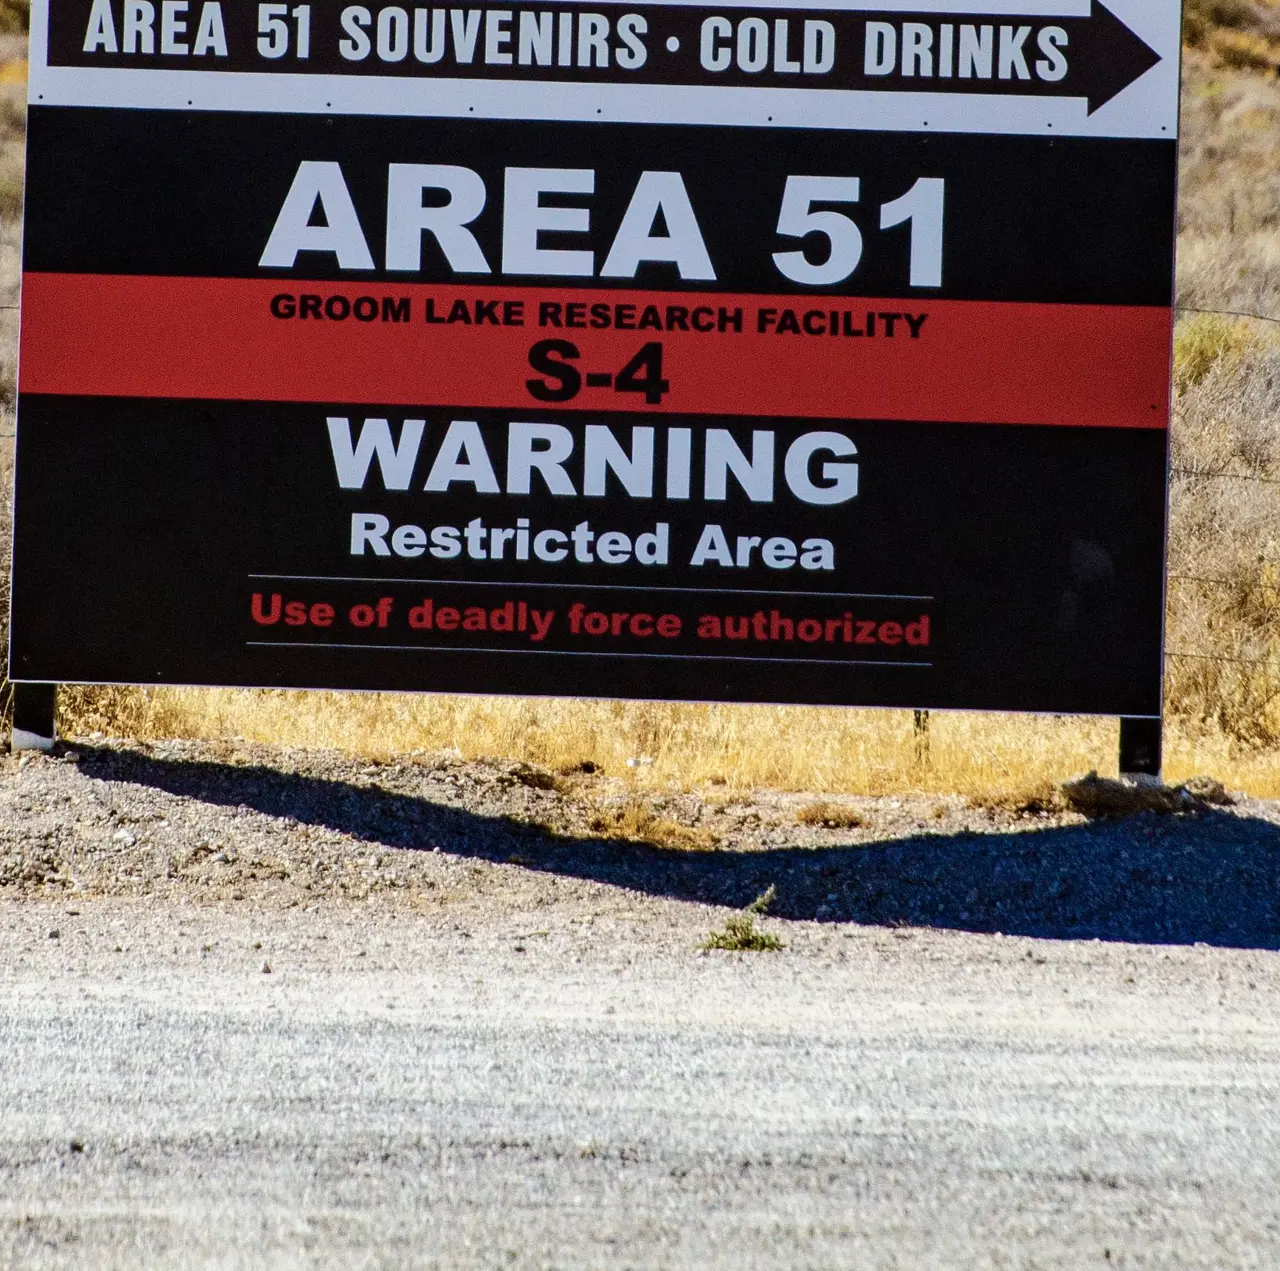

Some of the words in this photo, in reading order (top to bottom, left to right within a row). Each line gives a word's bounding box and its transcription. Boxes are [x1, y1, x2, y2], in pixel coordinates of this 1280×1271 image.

[83, 0, 228, 56] AREA
[257, 4, 310, 58] 51
[339, 6, 647, 69] SOUVENIRS
[700, 16, 835, 73] COLD
[864, 21, 1068, 81] DRINKS
[258, 161, 716, 280] AREA
[772, 175, 944, 287] 51
[270, 294, 410, 322] GROOM
[426, 299, 524, 326] LAKE
[539, 302, 742, 333] RESEARCH
[757, 309, 928, 338] FACILITY
[526, 339, 669, 404] S-4
[327, 417, 858, 505] WARNING
[351, 513, 669, 564] Restricted
[690, 525, 834, 570] Area
[251, 592, 335, 626] Use
[349, 597, 393, 627] of
[409, 599, 554, 640] deadly
[568, 603, 682, 637] force
[697, 610, 929, 645] authorized
